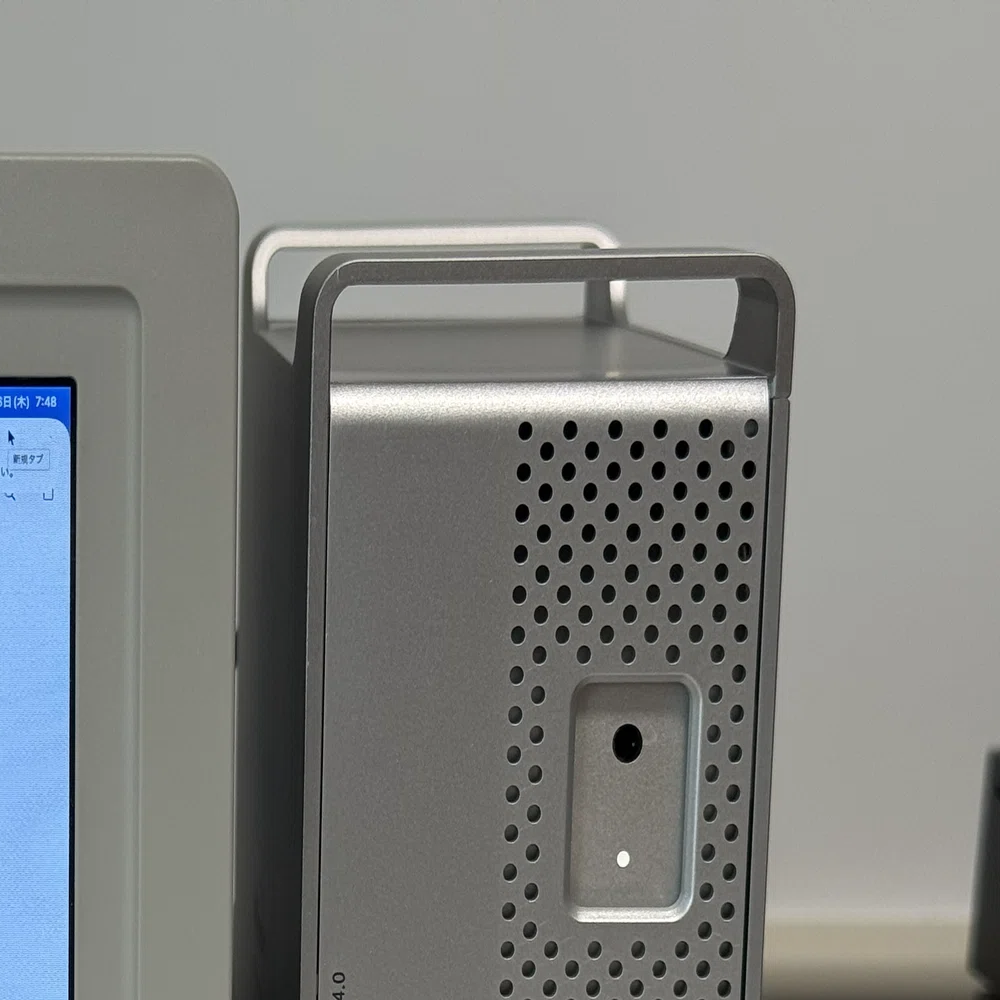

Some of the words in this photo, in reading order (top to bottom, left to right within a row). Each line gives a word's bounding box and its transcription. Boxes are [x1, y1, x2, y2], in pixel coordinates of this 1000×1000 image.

[35, 395, 57, 407] 7:48
[13, 453, 44, 465] 新規タブ
